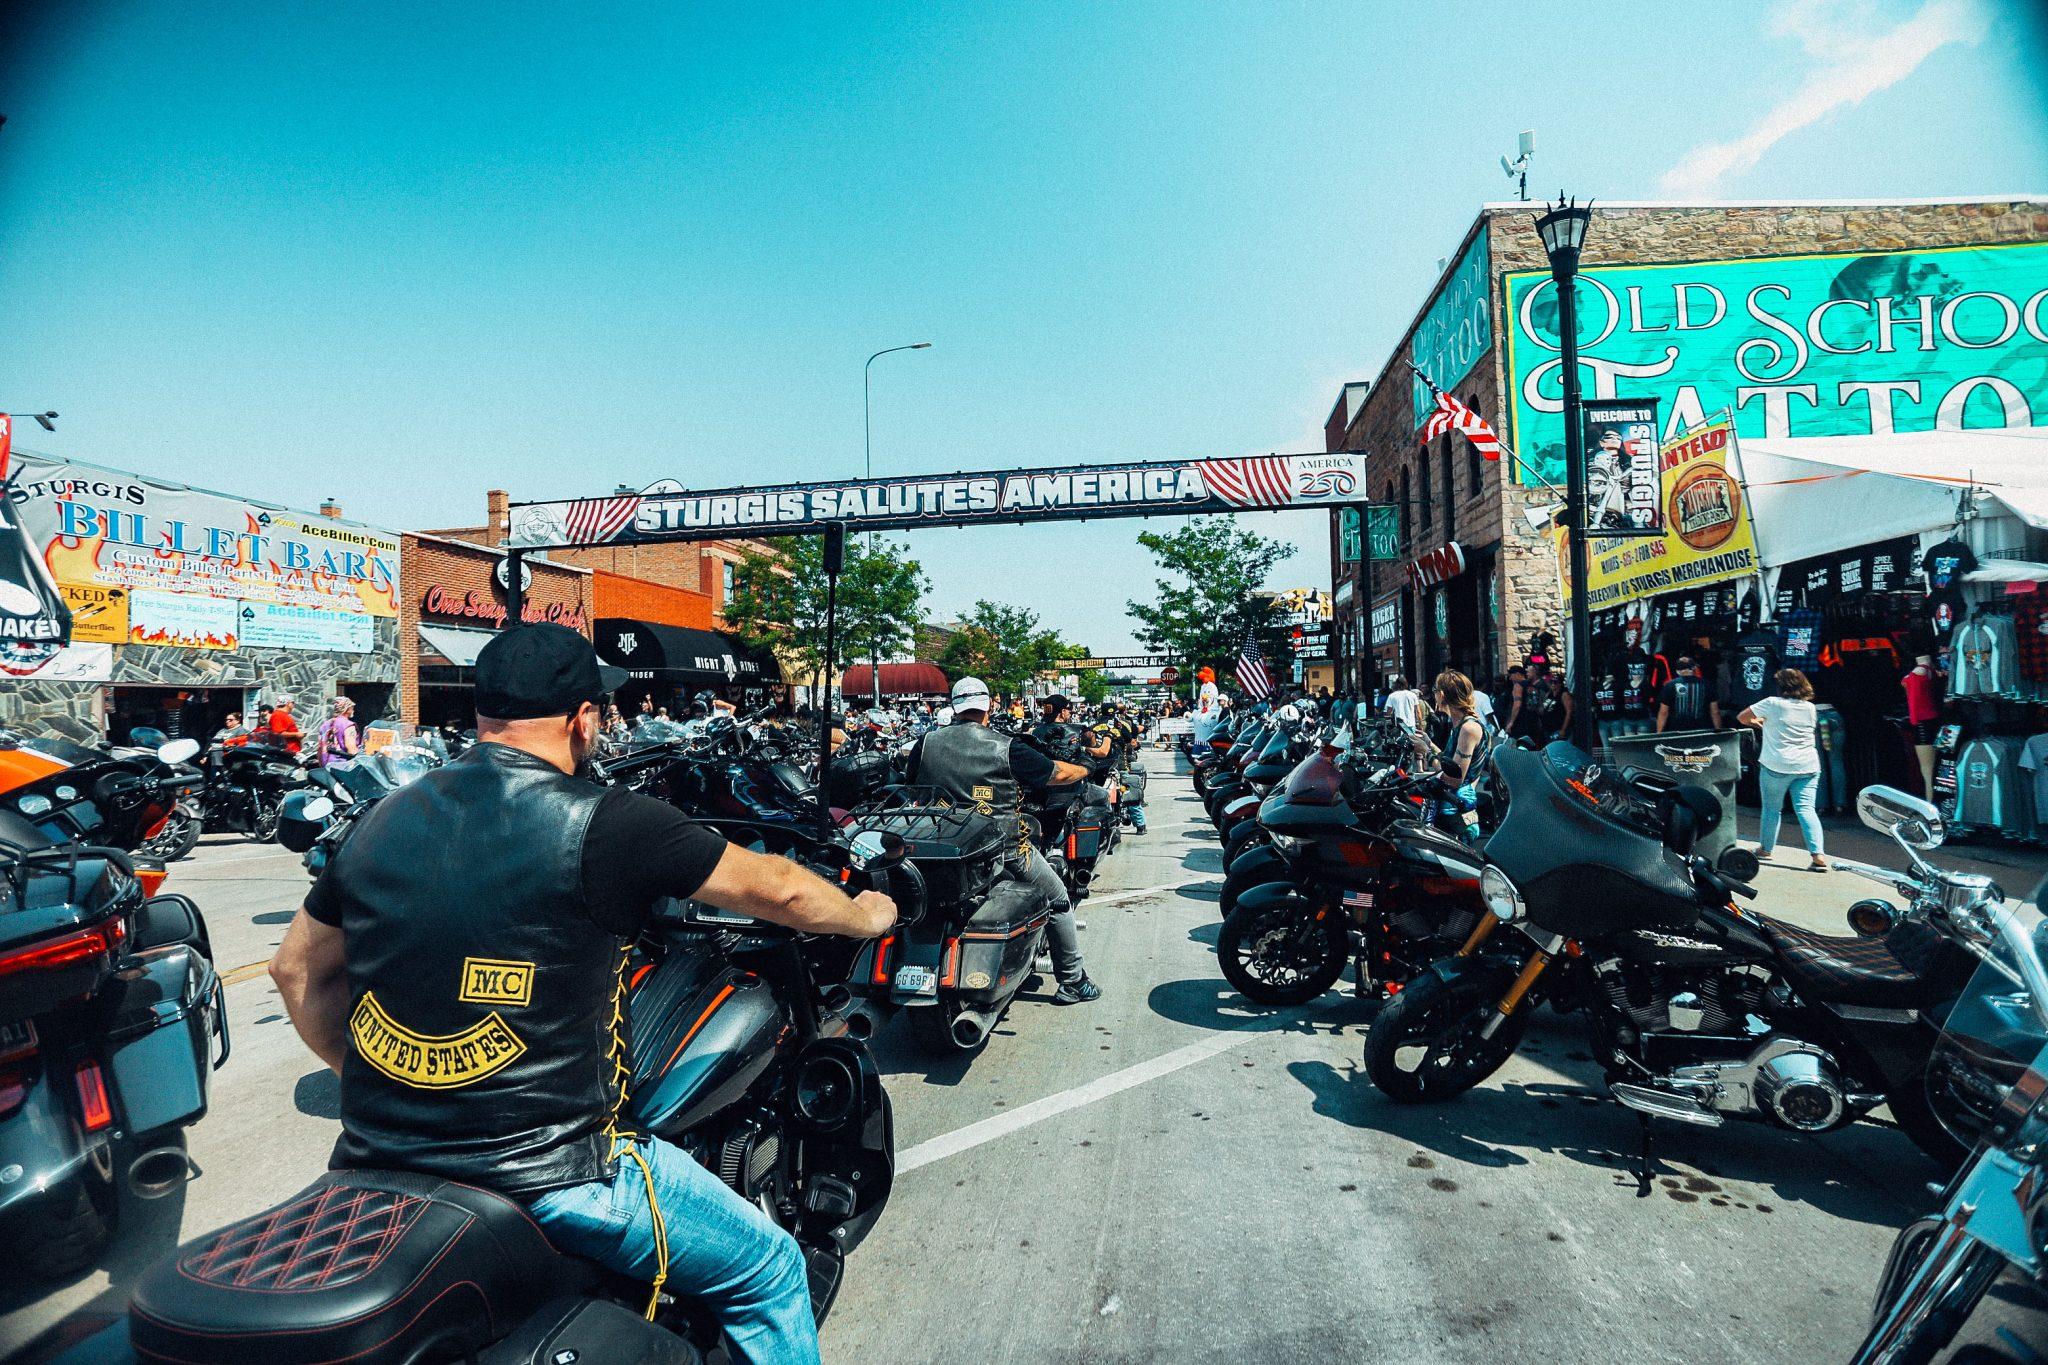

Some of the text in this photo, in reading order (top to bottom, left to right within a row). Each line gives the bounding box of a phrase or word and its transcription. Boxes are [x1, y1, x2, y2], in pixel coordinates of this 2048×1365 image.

[1519, 275, 1727, 351] OLD
[1590, 409, 1652, 423] WELCOME TO
[1299, 458, 1353, 470] AMERICA
[1629, 424, 1654, 523] STURGIS
[7, 479, 146, 505] STURGIS
[1299, 470, 1357, 497] 250
[637, 468, 1208, 530] STURGIS SALUTES AMERICA
[55, 499, 395, 584] BILLET BARN
[1650, 540, 1667, 558] $45
[114, 549, 176, 569] Custom
[182, 559, 223, 575] Billet
[225, 566, 261, 579] Parts
[1621, 580, 1630, 596] OF
[1630, 568, 1671, 593] STURGIS
[1673, 548, 1753, 583] MERCHANDISE
[427, 583, 464, 614] One
[465, 590, 508, 629] Sexy
[520, 597, 548, 623] iker
[0, 617, 61, 638] AKED
[630, 671, 654, 679] RIDER
[695, 656, 719, 670] NIGHT
[1105, 657, 1149, 668] MOTORCYCLE
[1162, 672, 1179, 681] STOP
[1685, 754, 1712, 763] BROWN
[975, 789, 990, 797] MC
[471, 969, 523, 995] MC
[357, 1007, 513, 1076] UNITED STATES
